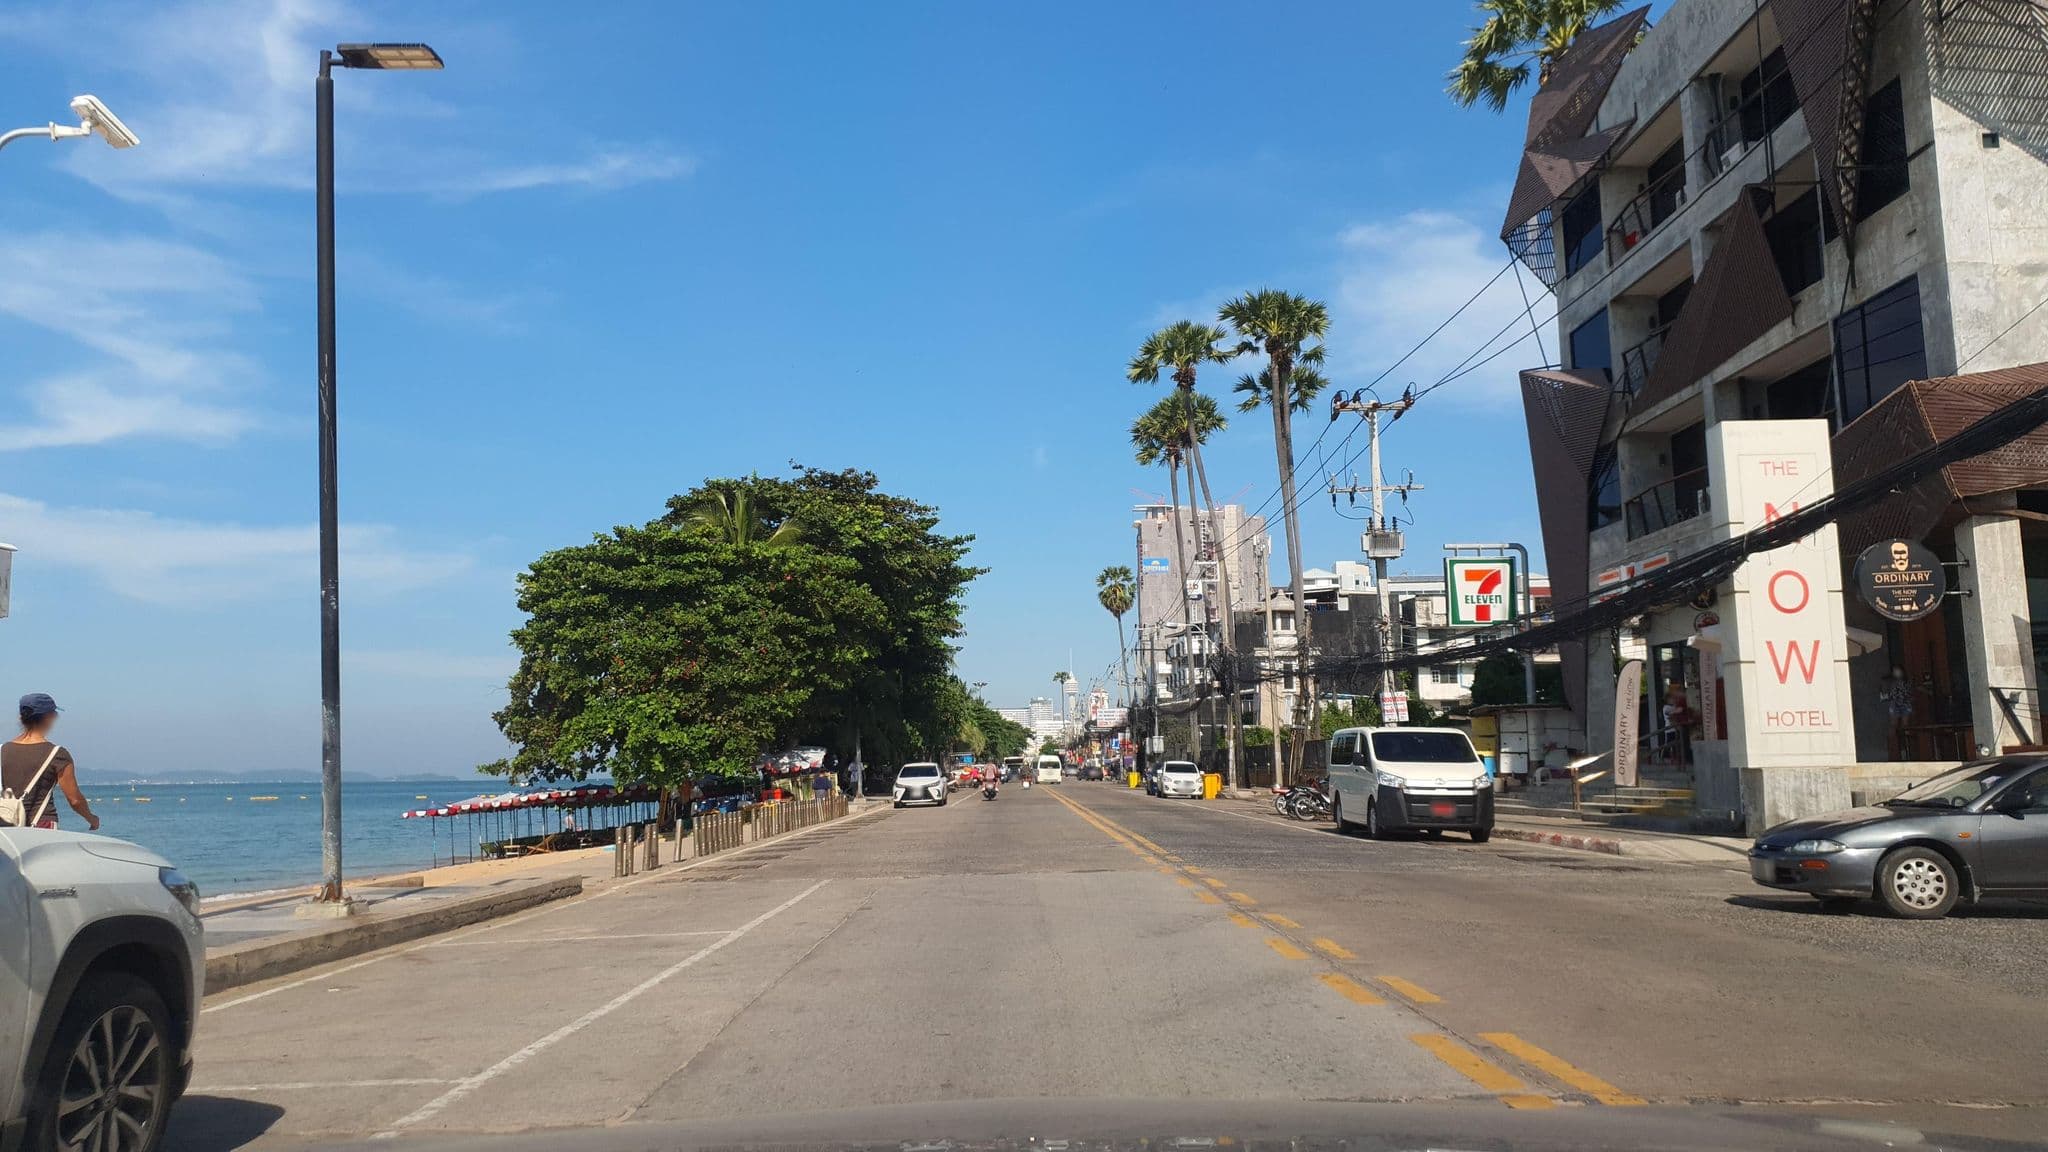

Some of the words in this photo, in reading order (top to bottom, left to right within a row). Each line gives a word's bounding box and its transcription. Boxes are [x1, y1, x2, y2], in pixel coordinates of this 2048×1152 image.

[1759, 460, 1799, 477] THE
[1874, 572, 1930, 583] ORDINARY
[1464, 569, 1502, 621] 7
[1766, 710, 1832, 727] HOTEL
[1617, 713, 1629, 775] ORDINARY
